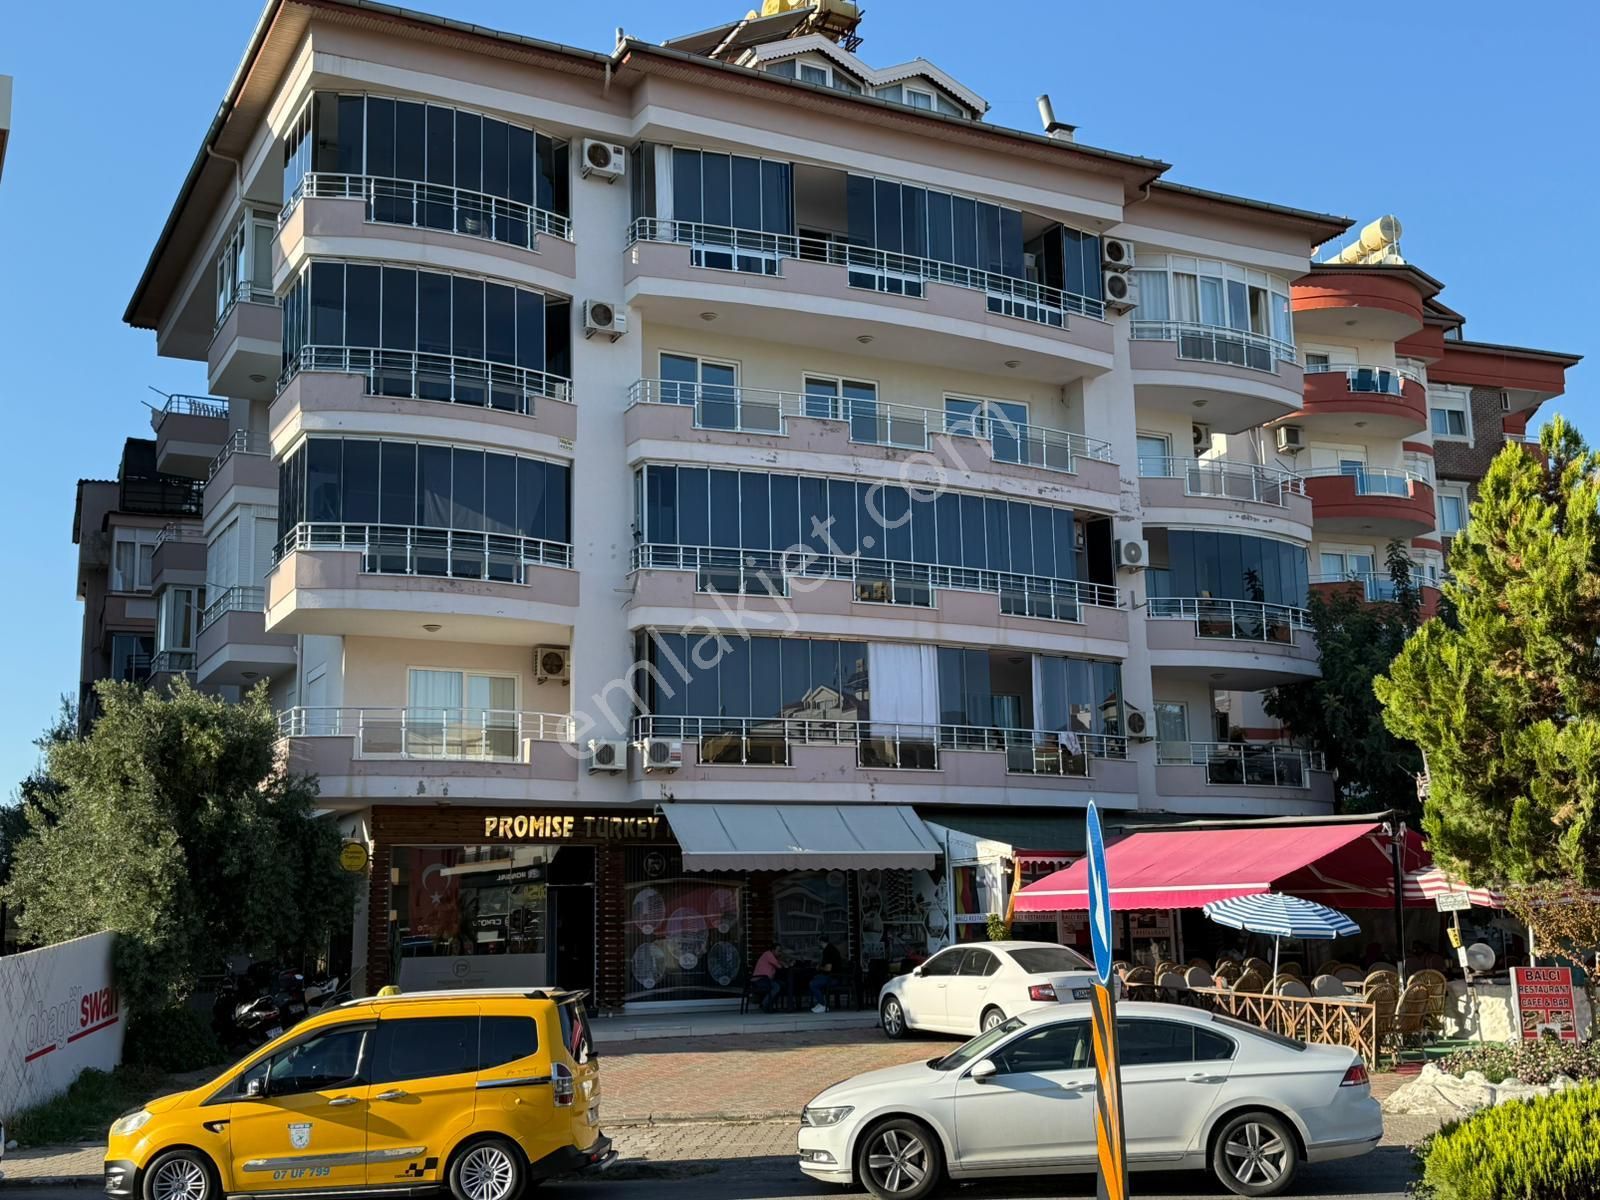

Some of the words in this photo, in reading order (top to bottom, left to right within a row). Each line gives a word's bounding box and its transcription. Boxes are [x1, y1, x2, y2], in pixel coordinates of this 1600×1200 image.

[485, 815, 574, 839] PROMISE
[584, 816, 660, 840] TURKEY
[1525, 970, 1561, 981] BALCI
[1518, 985, 1570, 994] RESTAURANT
[1521, 998, 1543, 1007] CAFE
[1544, 998, 1551, 1007] &
[1552, 998, 1570, 1007] BAR
[273, 1170, 288, 1180] 07
[290, 1168, 305, 1179] UF
